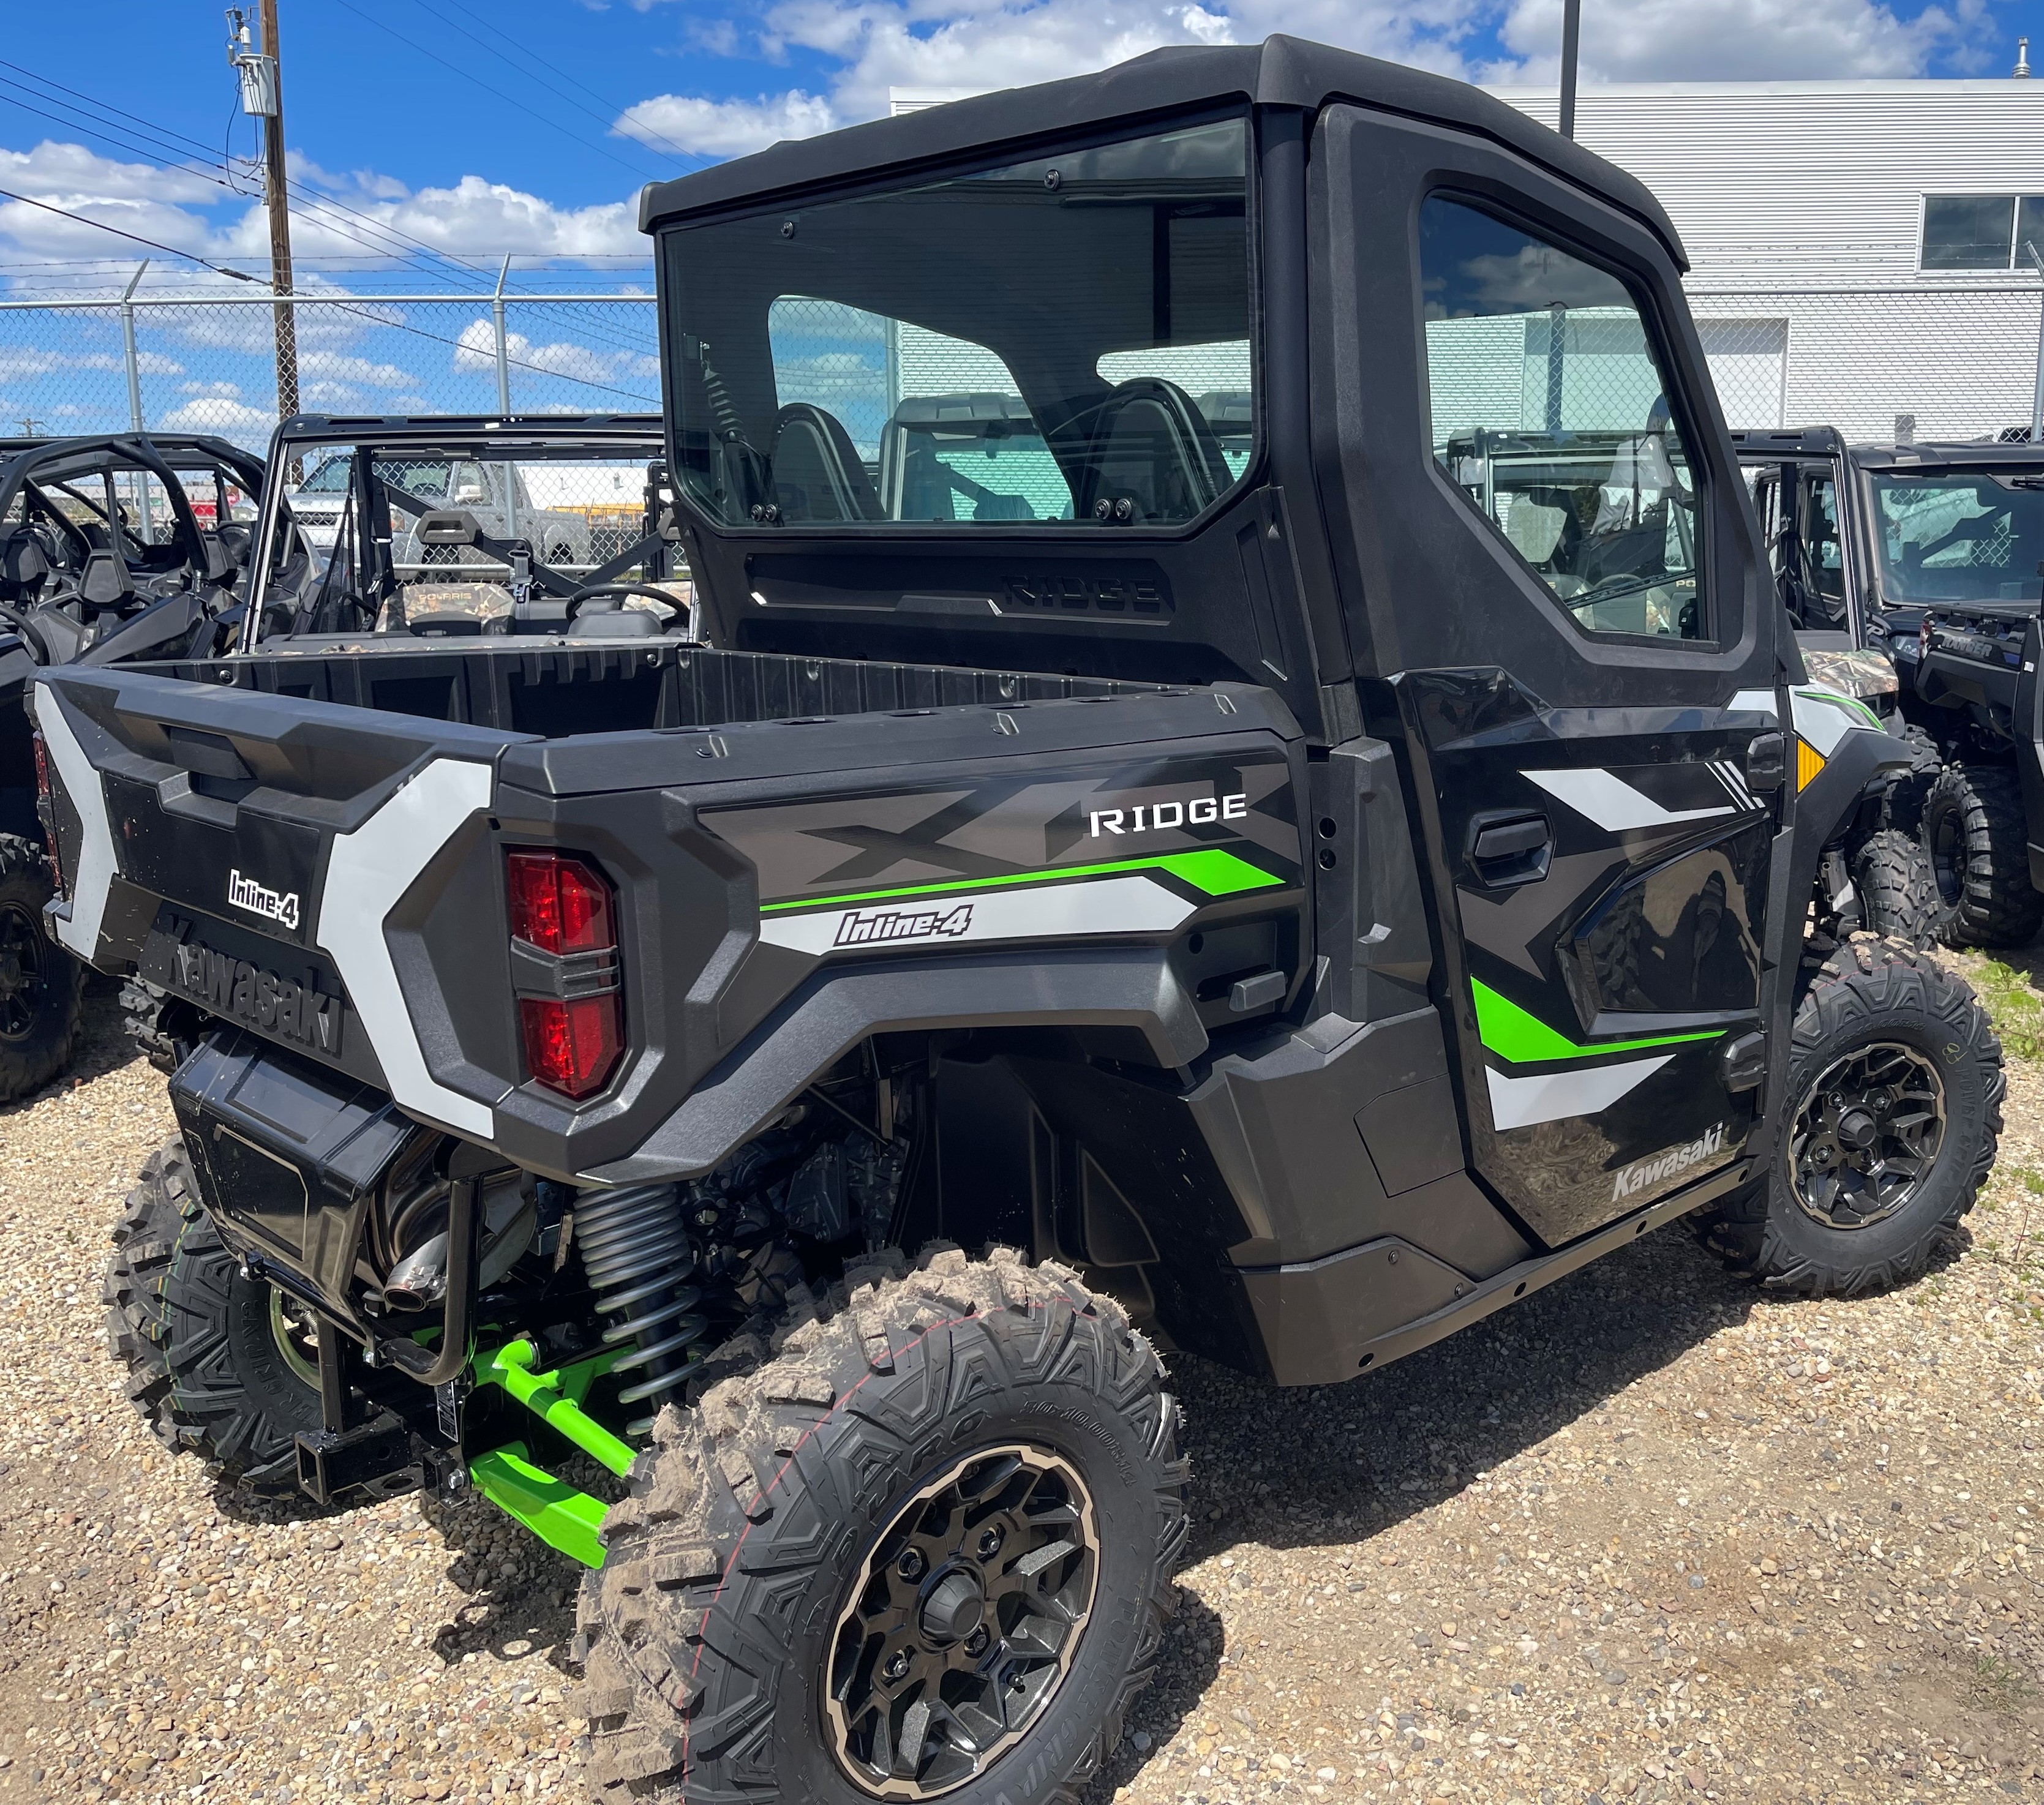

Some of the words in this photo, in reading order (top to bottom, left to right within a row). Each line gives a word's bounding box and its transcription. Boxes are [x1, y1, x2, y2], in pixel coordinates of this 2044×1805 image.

[418, 593, 472, 602] POLARIS
[1000, 574, 1160, 606] RIDGE
[1941, 636, 1993, 658] RANGER
[1090, 794, 1247, 838] RIDGE
[228, 868, 299, 930] Inline-4
[833, 903, 974, 947] Inline-4
[165, 913, 344, 1055] Kawasaki
[1611, 1120, 1724, 1203] Kawasaki
[245, 1344, 286, 1396] GRIP
[832, 1407, 993, 1582] DURO
[1076, 1596, 1139, 1716] POWER
[1023, 1717, 1079, 1798] GRIP
